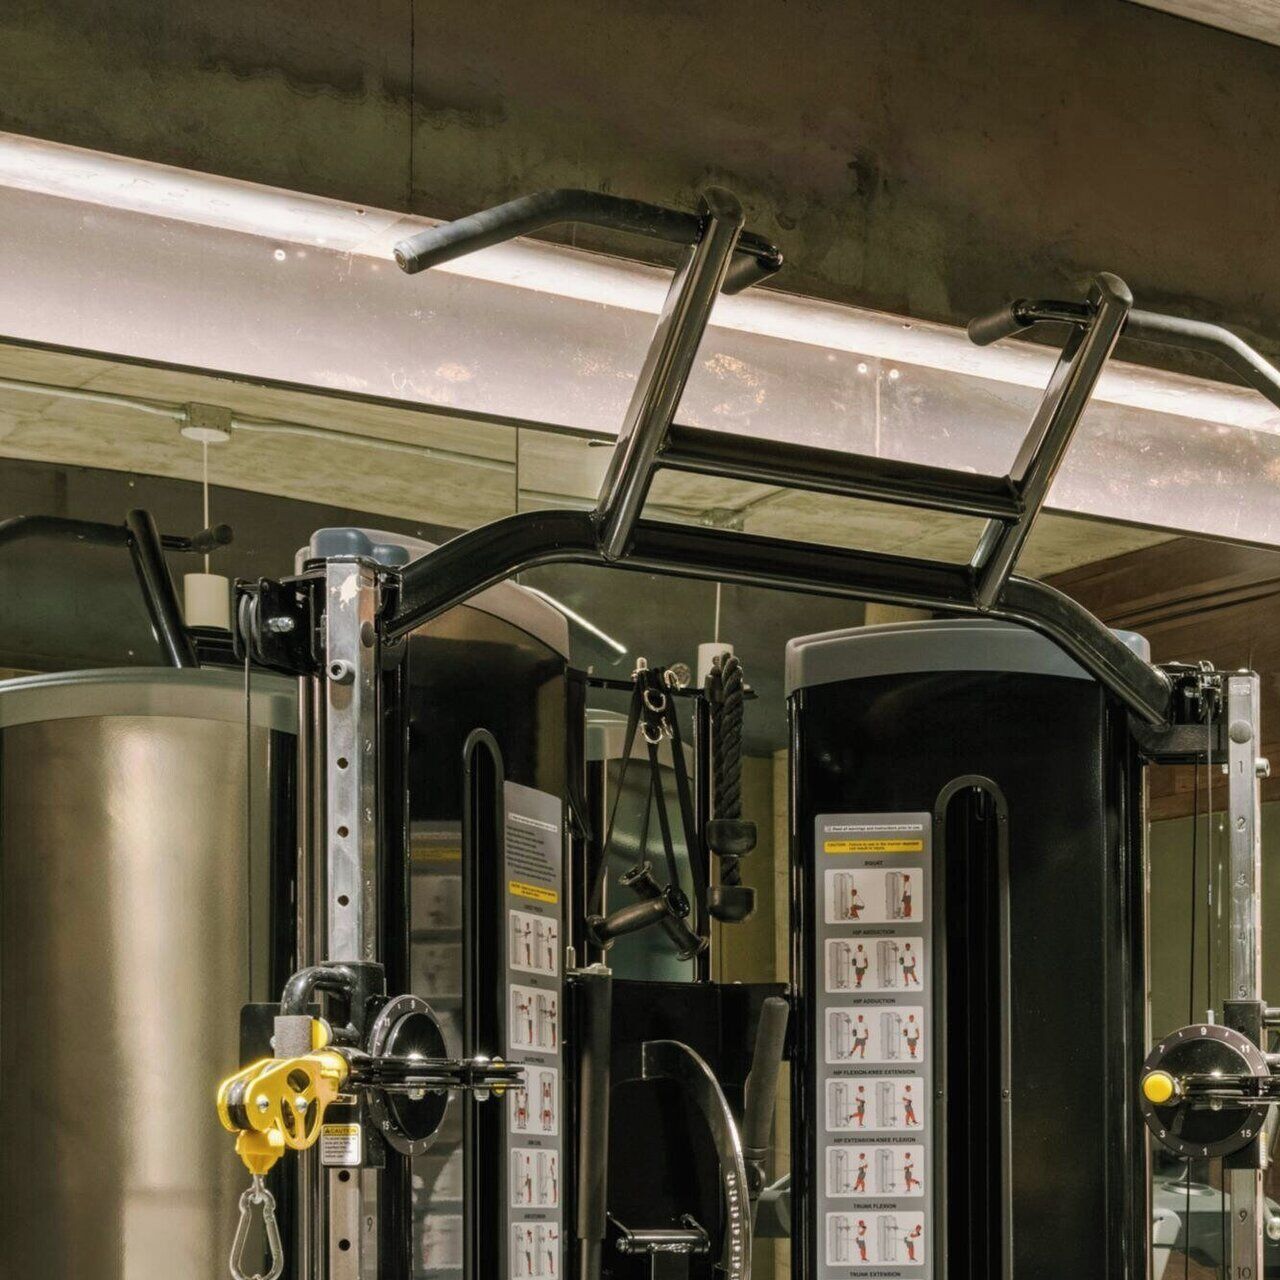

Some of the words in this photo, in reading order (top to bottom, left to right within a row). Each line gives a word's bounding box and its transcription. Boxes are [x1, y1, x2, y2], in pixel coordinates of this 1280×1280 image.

[1238, 760, 1244, 773] 1
[1236, 816, 1246, 829] 2
[1200, 1027, 1207, 1036] 9
[1159, 1045, 1165, 1053] 7
[1160, 1130, 1166, 1138] 3
[1240, 1130, 1251, 1138] 15
[1239, 1210, 1248, 1222] 9
[1236, 1266, 1252, 1280] 10
